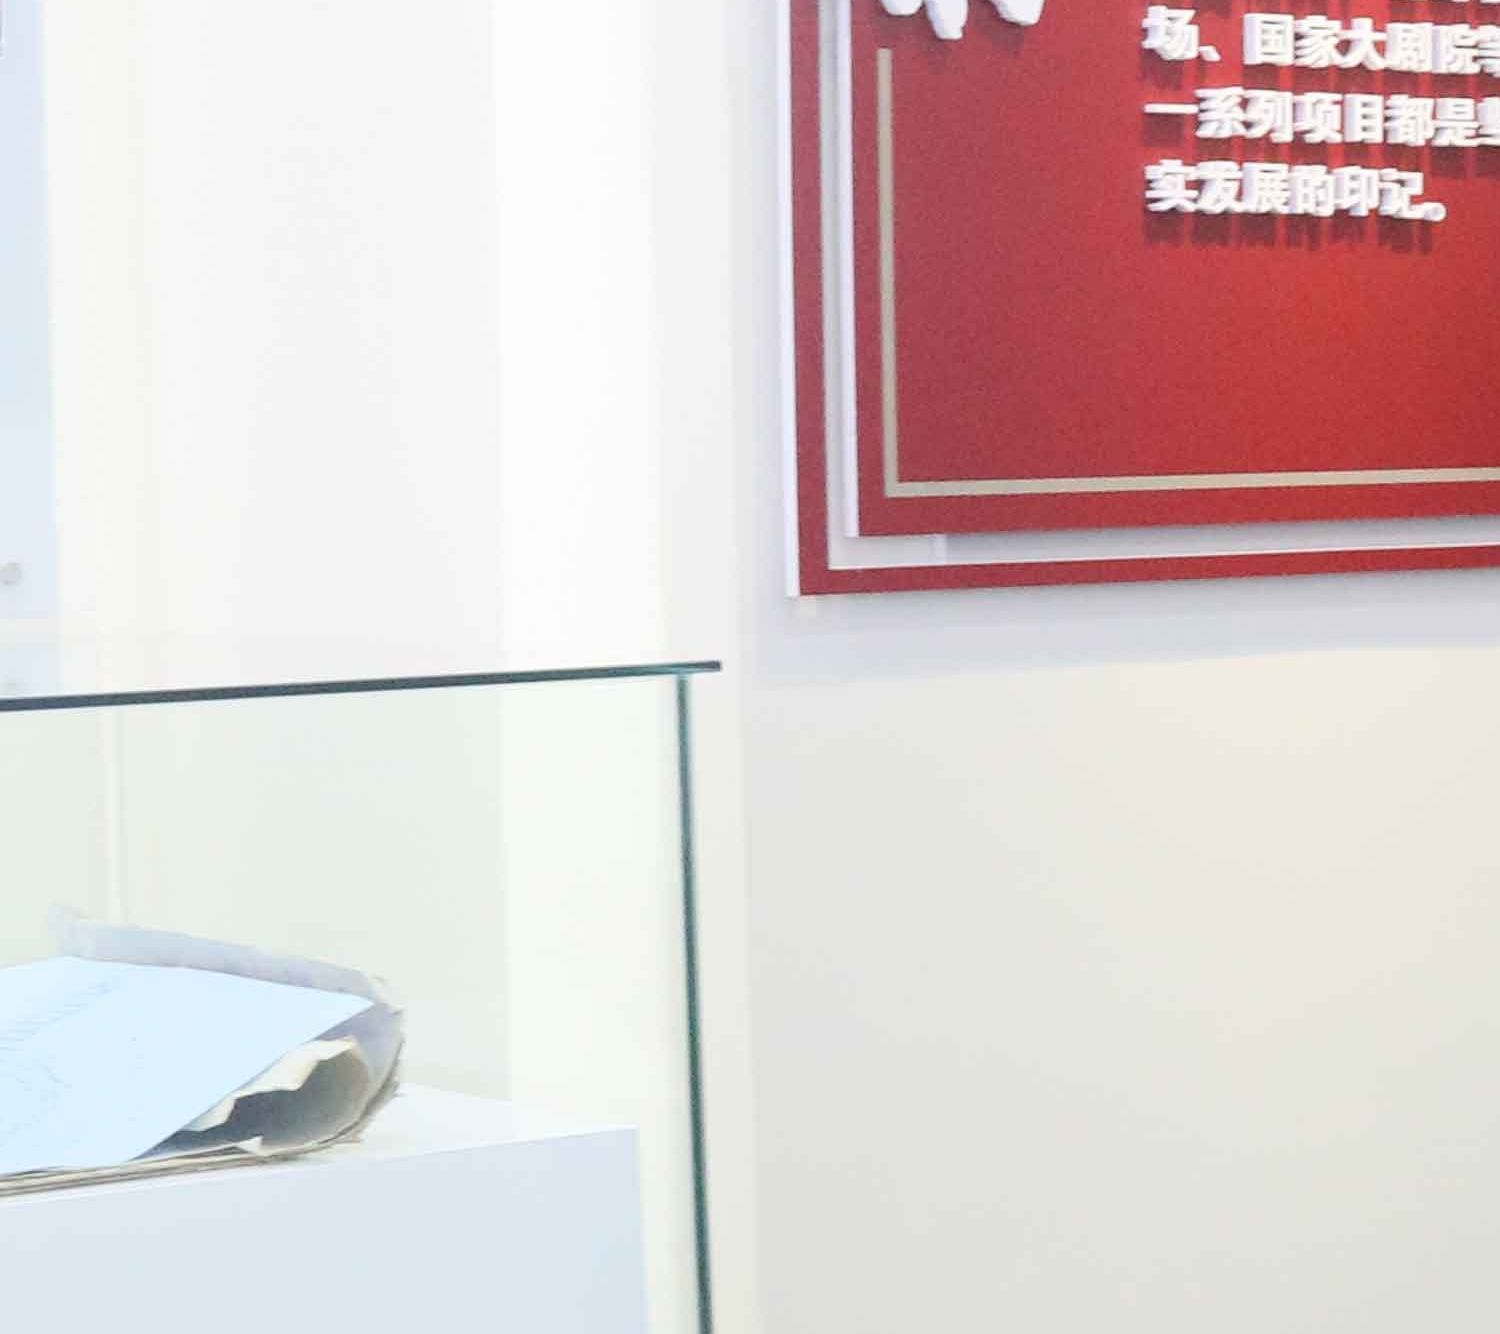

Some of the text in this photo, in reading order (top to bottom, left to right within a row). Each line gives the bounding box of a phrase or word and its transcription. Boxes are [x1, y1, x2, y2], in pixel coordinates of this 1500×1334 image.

[1144, 159, 1447, 222] 实发展的印记。
